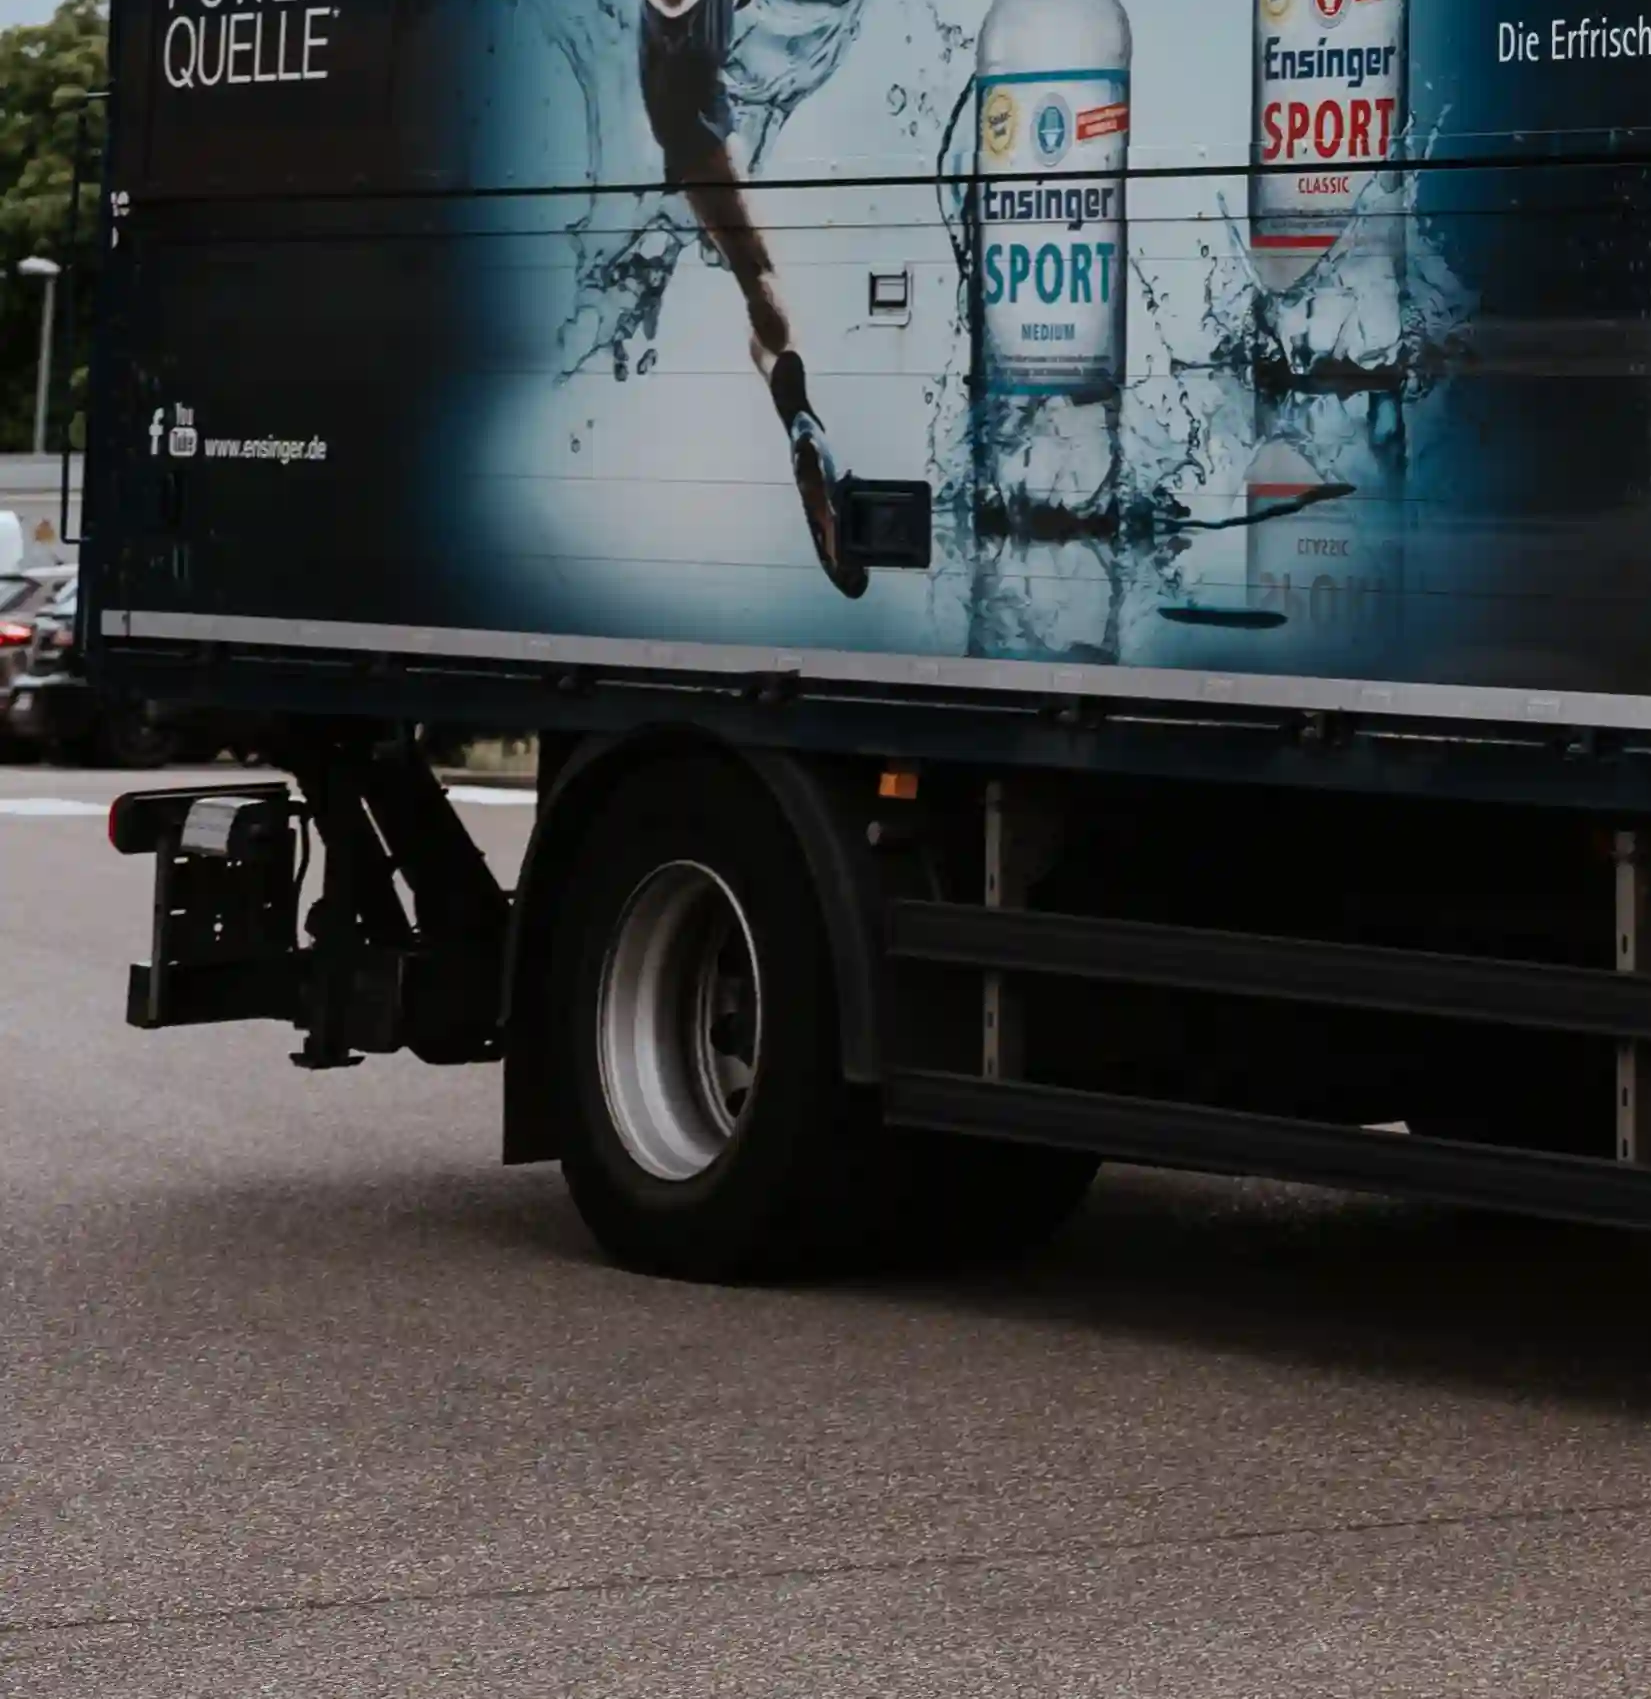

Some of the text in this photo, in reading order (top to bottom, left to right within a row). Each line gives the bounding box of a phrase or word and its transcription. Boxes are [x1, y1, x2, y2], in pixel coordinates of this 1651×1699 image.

[1264, 37, 1397, 88] Ensinger
[1499, 22, 1538, 63] Die
[1262, 98, 1395, 160] SPORT
[1298, 177, 1349, 194] CLASSIC
[985, 243, 1115, 304] SPORT
[1022, 323, 1075, 340] MEDIUM
[204, 433, 327, 465] www.ensinger.de
